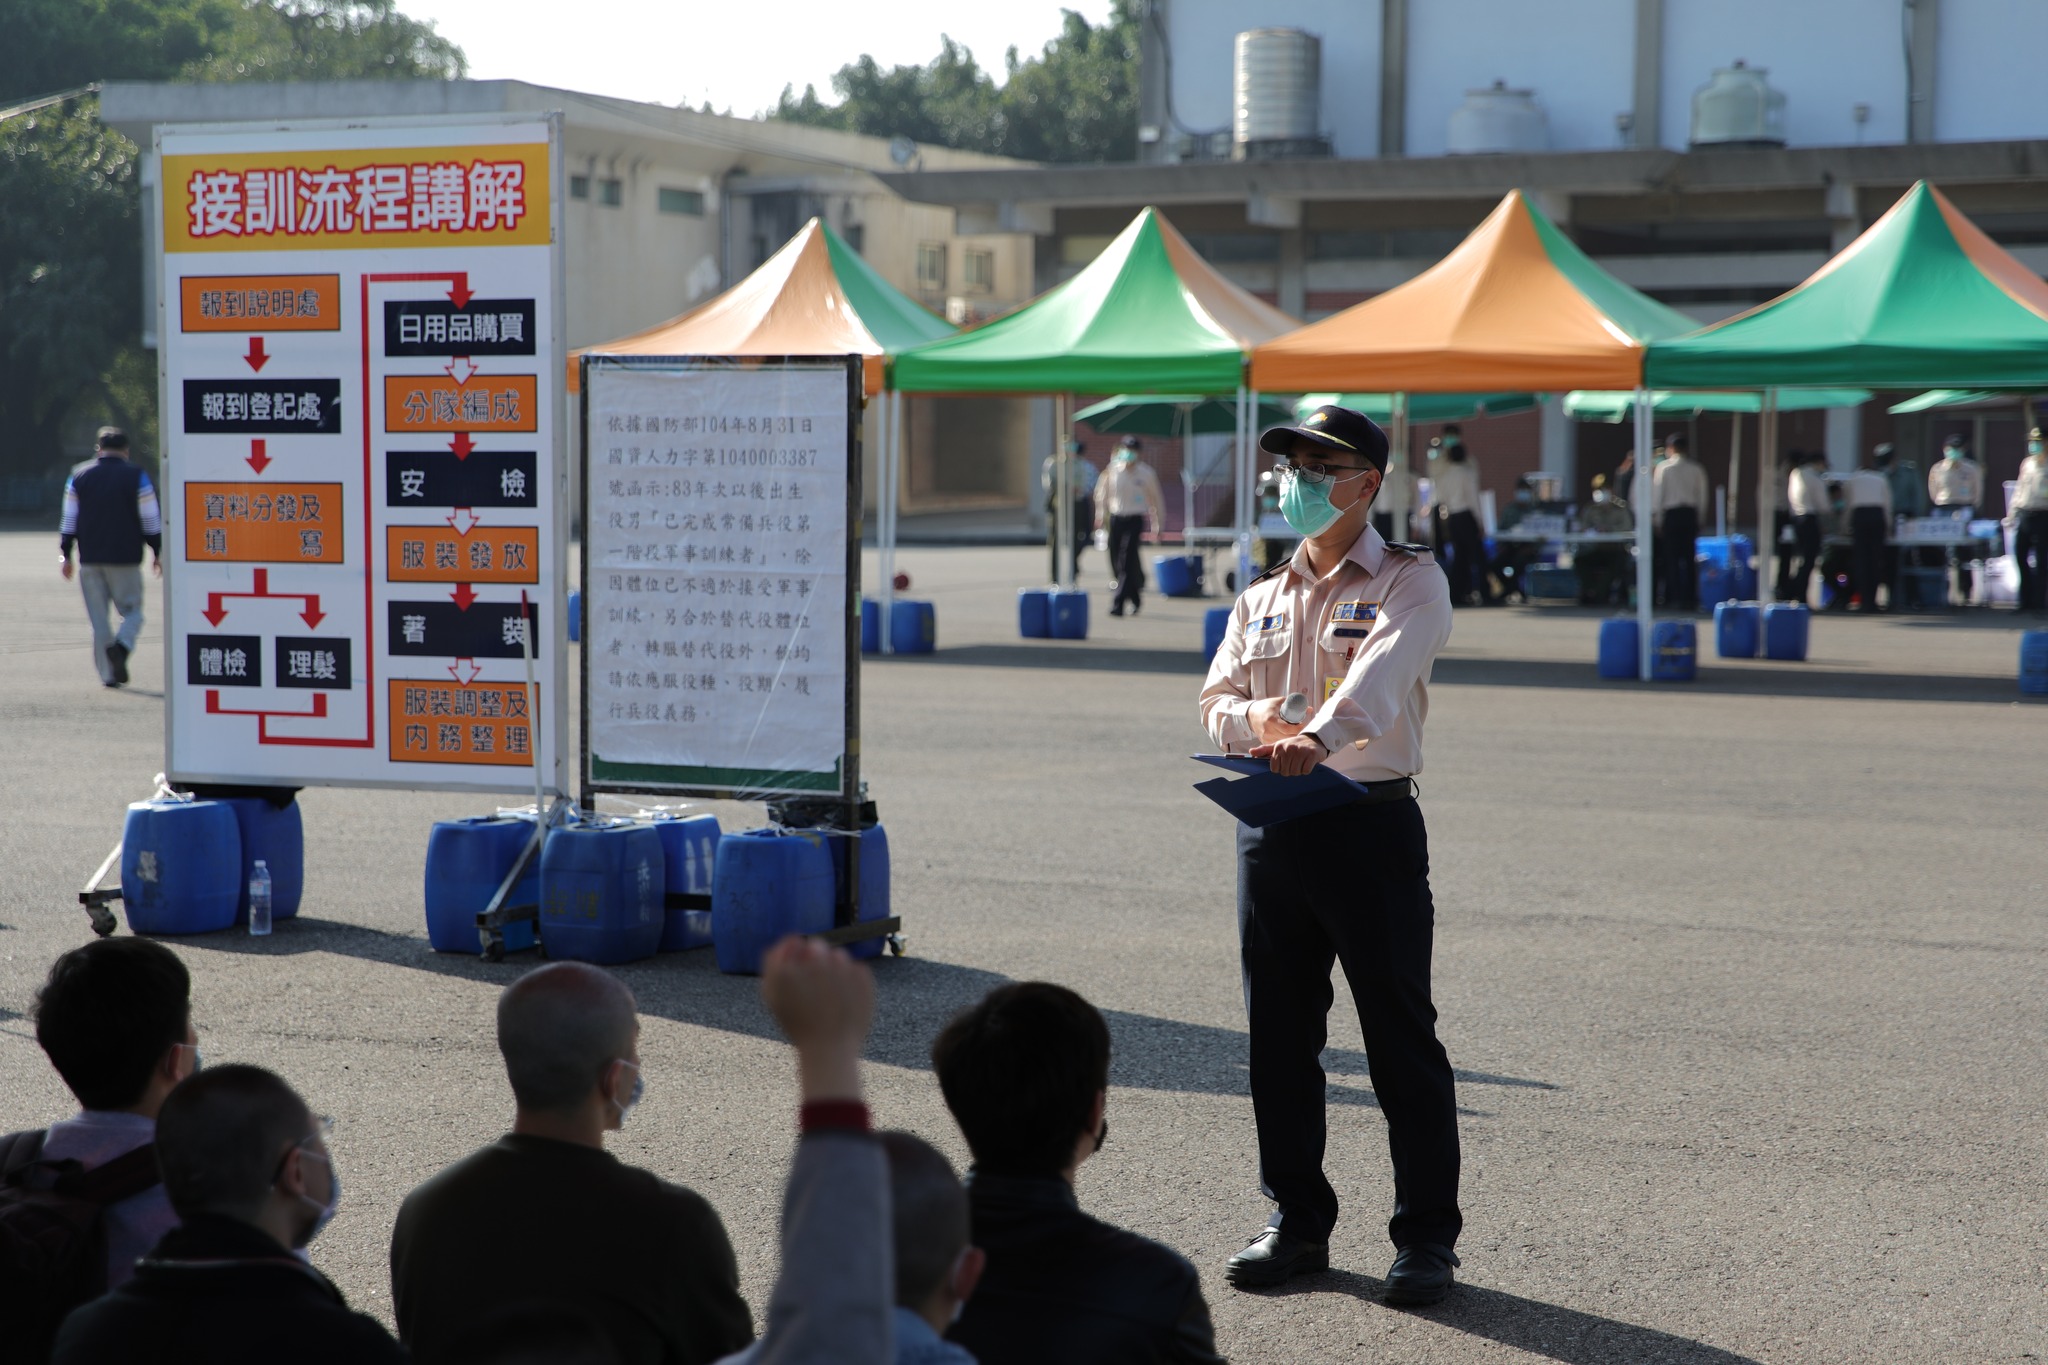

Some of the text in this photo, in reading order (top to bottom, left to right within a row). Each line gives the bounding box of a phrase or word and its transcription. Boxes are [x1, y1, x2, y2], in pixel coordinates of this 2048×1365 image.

[187, 160, 525, 238] 接訓流程講解
[200, 290, 320, 318] 報到說明處
[399, 313, 524, 344] 日用品購買
[202, 392, 321, 422] 報到登記處
[403, 389, 521, 424] 分隊編成
[204, 494, 322, 523] 資料分發及
[401, 541, 528, 570] 服裝發放
[200, 648, 247, 677] 體檢
[288, 650, 337, 680] 理髮
[405, 688, 528, 719] 服裝調整及
